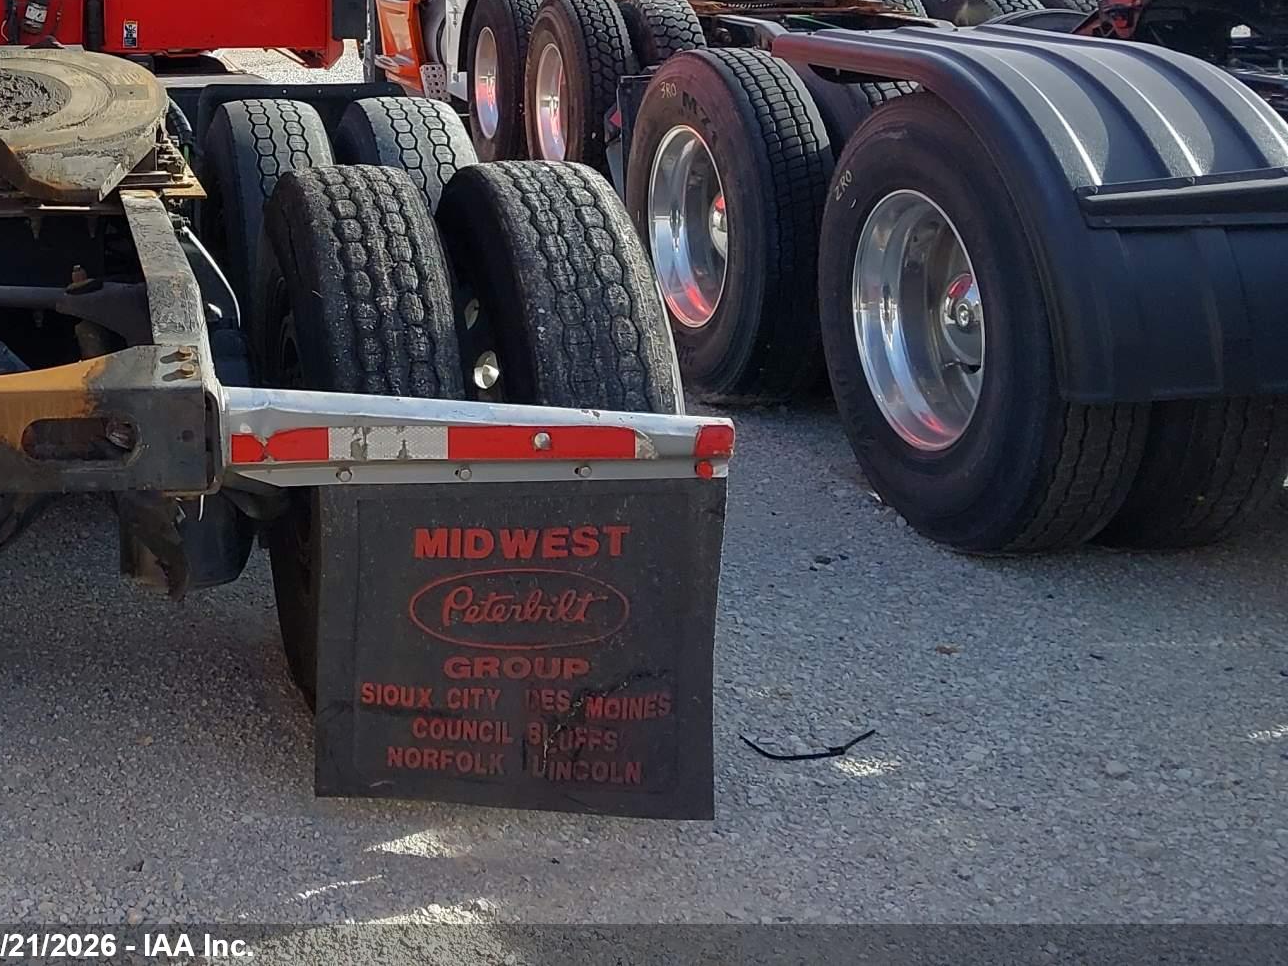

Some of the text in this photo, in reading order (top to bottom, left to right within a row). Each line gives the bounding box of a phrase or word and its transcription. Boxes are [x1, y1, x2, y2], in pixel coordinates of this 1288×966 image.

[414, 526, 631, 559] MIDWEST
[441, 585, 608, 626] Peterbilt
[443, 656, 590, 679] GROUP
[361, 682, 433, 709] SIOUX
[447, 687, 501, 710] CITY
[585, 690, 673, 720] MOINES
[412, 718, 513, 745] COUNCIL
[387, 746, 642, 785] NORFOLK LINCOLN
